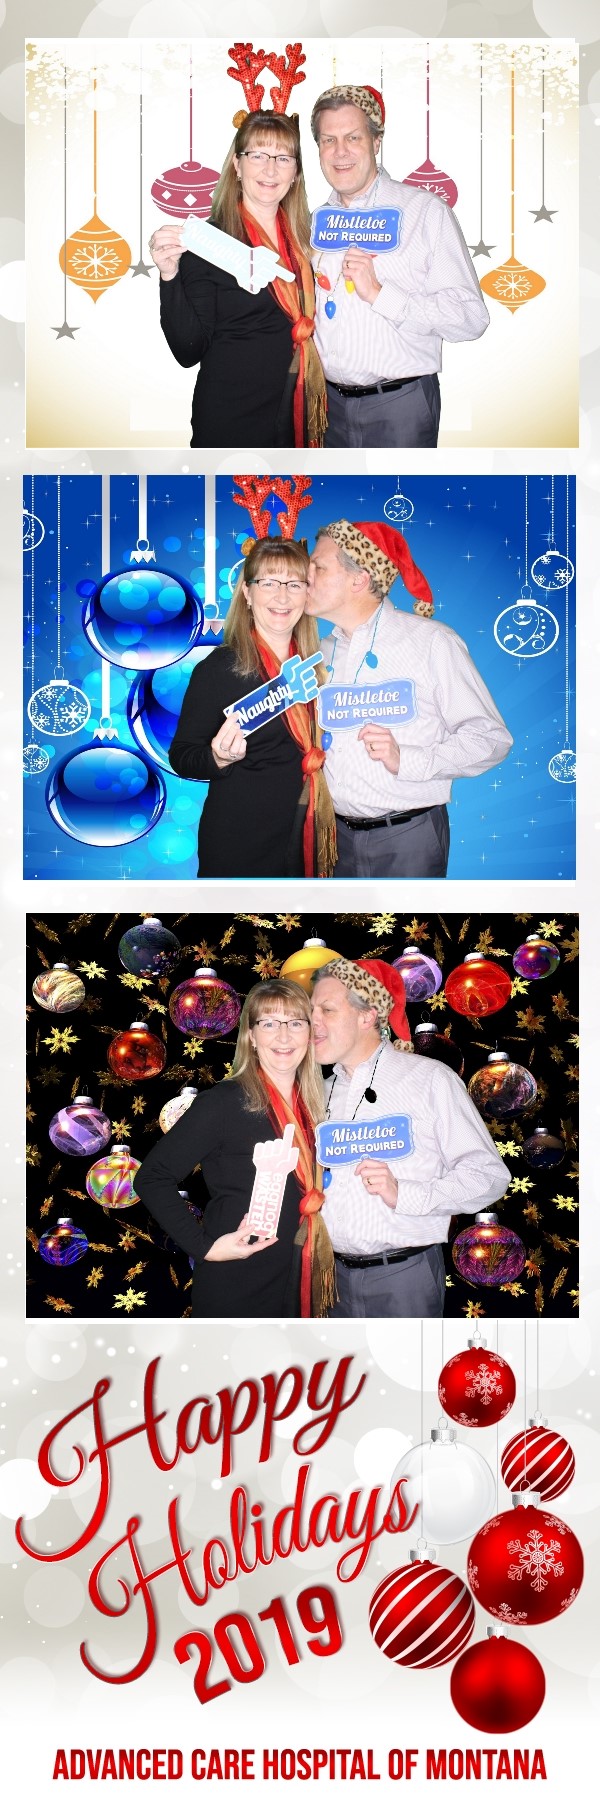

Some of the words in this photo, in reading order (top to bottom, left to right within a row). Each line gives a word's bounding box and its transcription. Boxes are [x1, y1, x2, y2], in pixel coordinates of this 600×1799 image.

[326, 214, 387, 230] Mistletoe
[318, 231, 339, 241] NOT
[341, 231, 392, 243] REQUIRED
[236, 683, 300, 727] Naughty
[333, 689, 400, 707] Mistletoe
[327, 709, 350, 721] NOT
[352, 705, 409, 719] REQUIRED
[331, 1125, 397, 1144] Mistletoe
[325, 1145, 348, 1157] NOT
[350, 1140, 405, 1154] REQUIRED
[261, 1172, 284, 1232] eggnog
